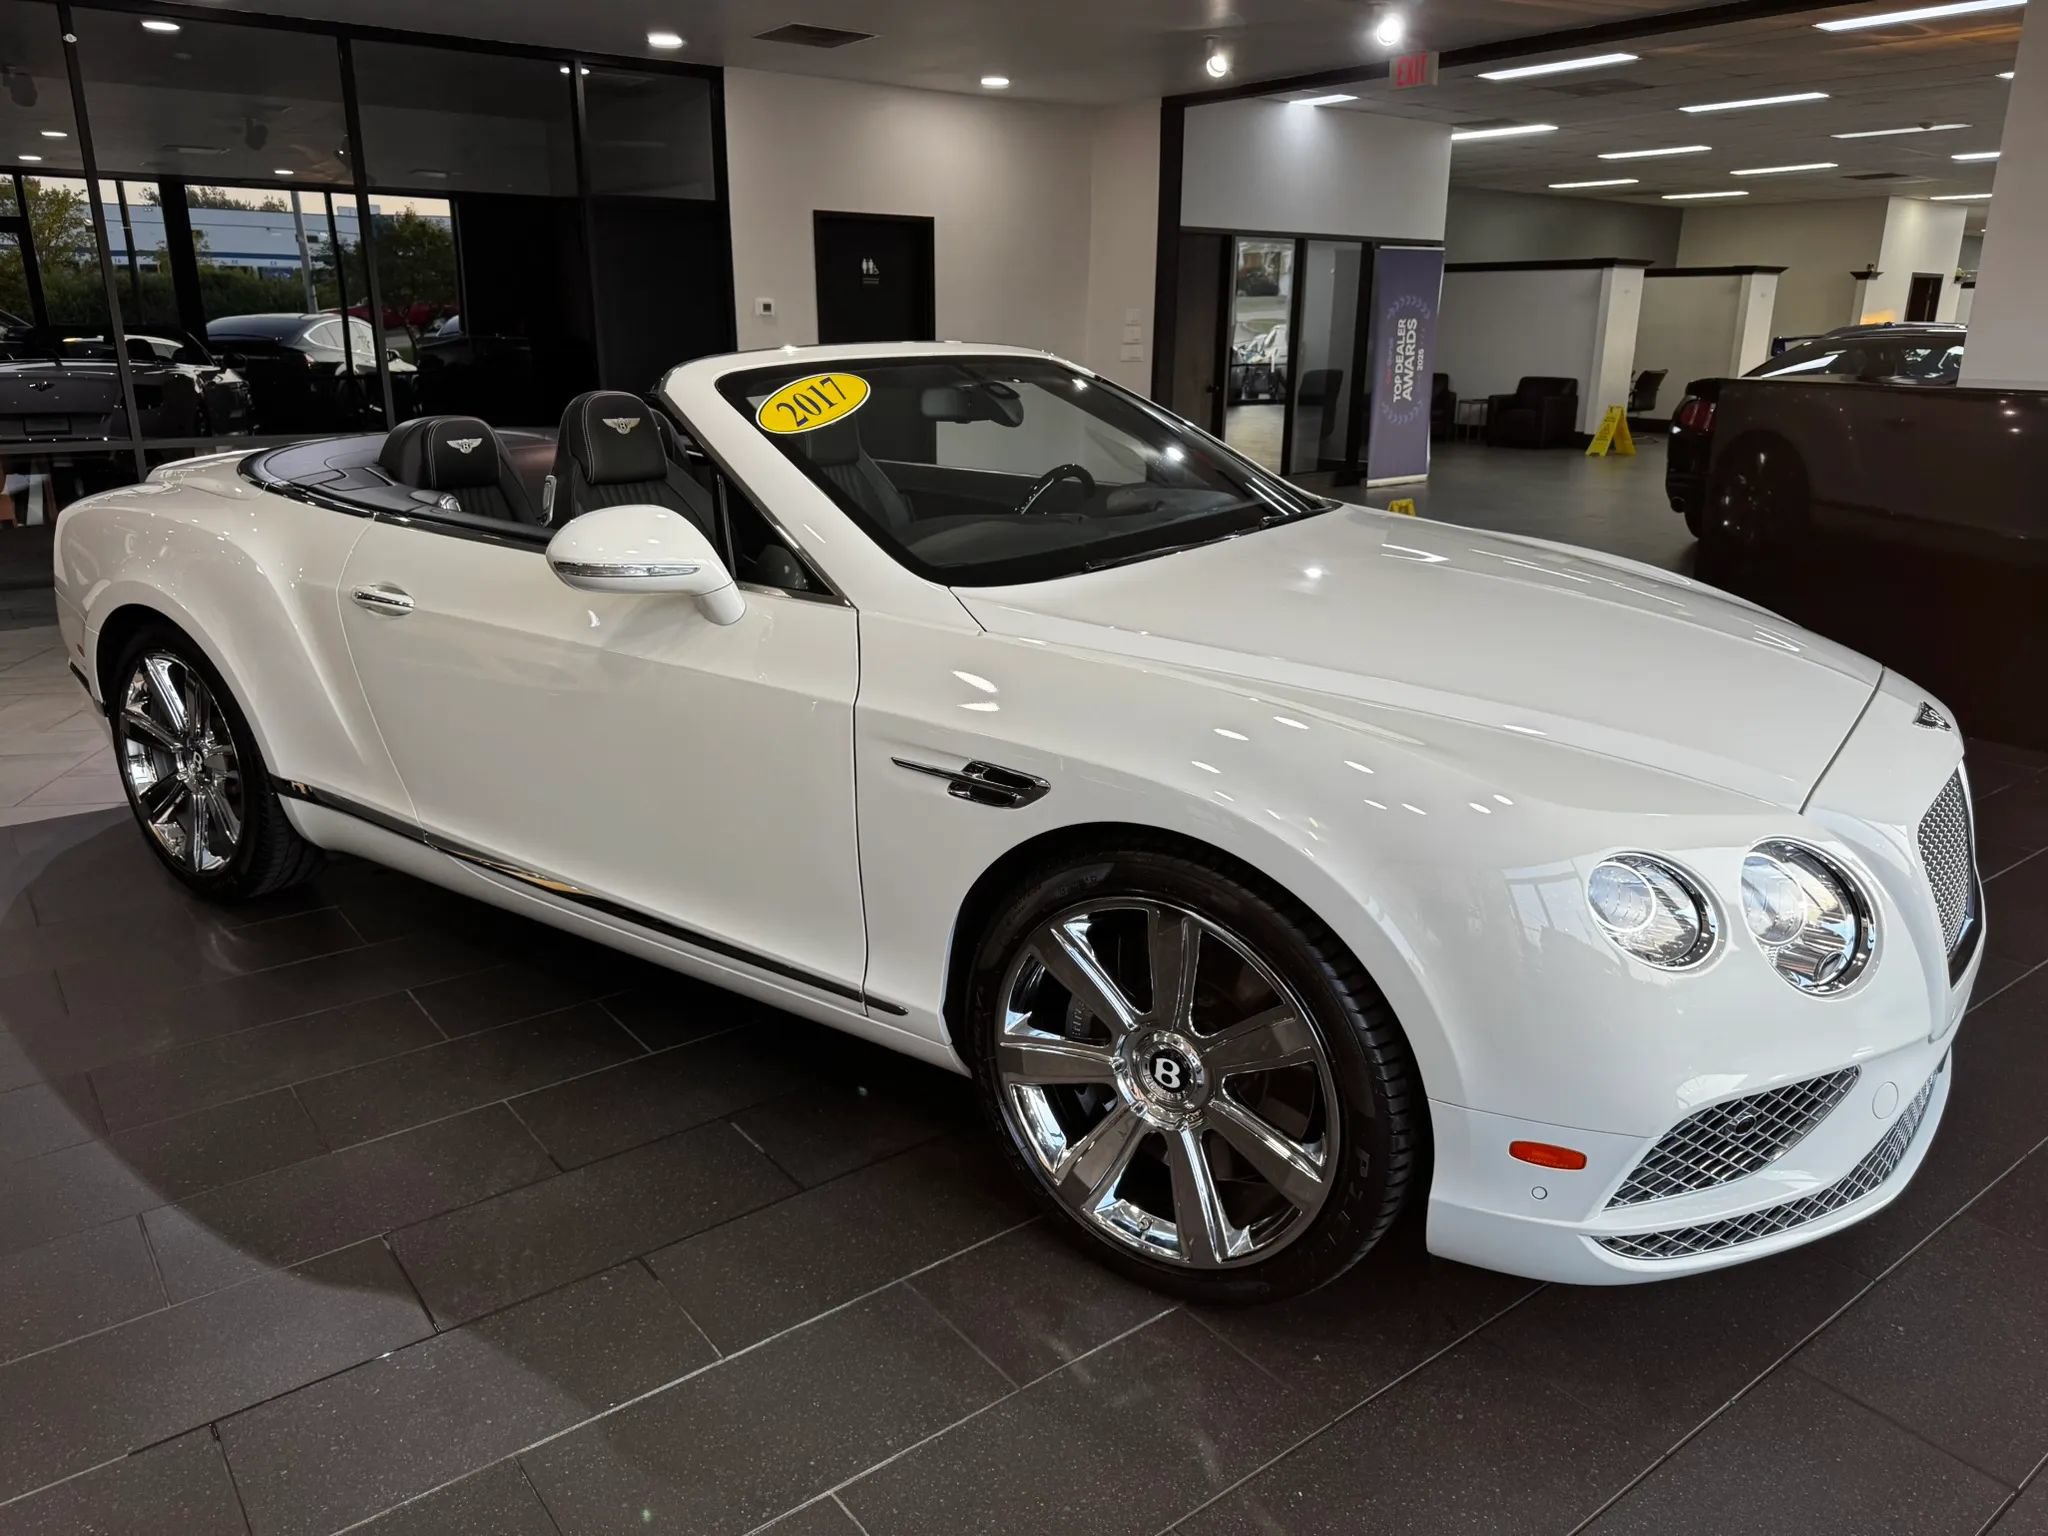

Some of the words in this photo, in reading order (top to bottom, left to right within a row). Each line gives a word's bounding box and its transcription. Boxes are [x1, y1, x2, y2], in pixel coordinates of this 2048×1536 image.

[1396, 54, 1428, 88] EXIT
[1394, 319, 1407, 373] DEALER
[1402, 318, 1418, 401] AWARDS
[776, 377, 847, 427] 2017
[1393, 376, 1403, 402] TOP
[1154, 1058, 1181, 1089] B
